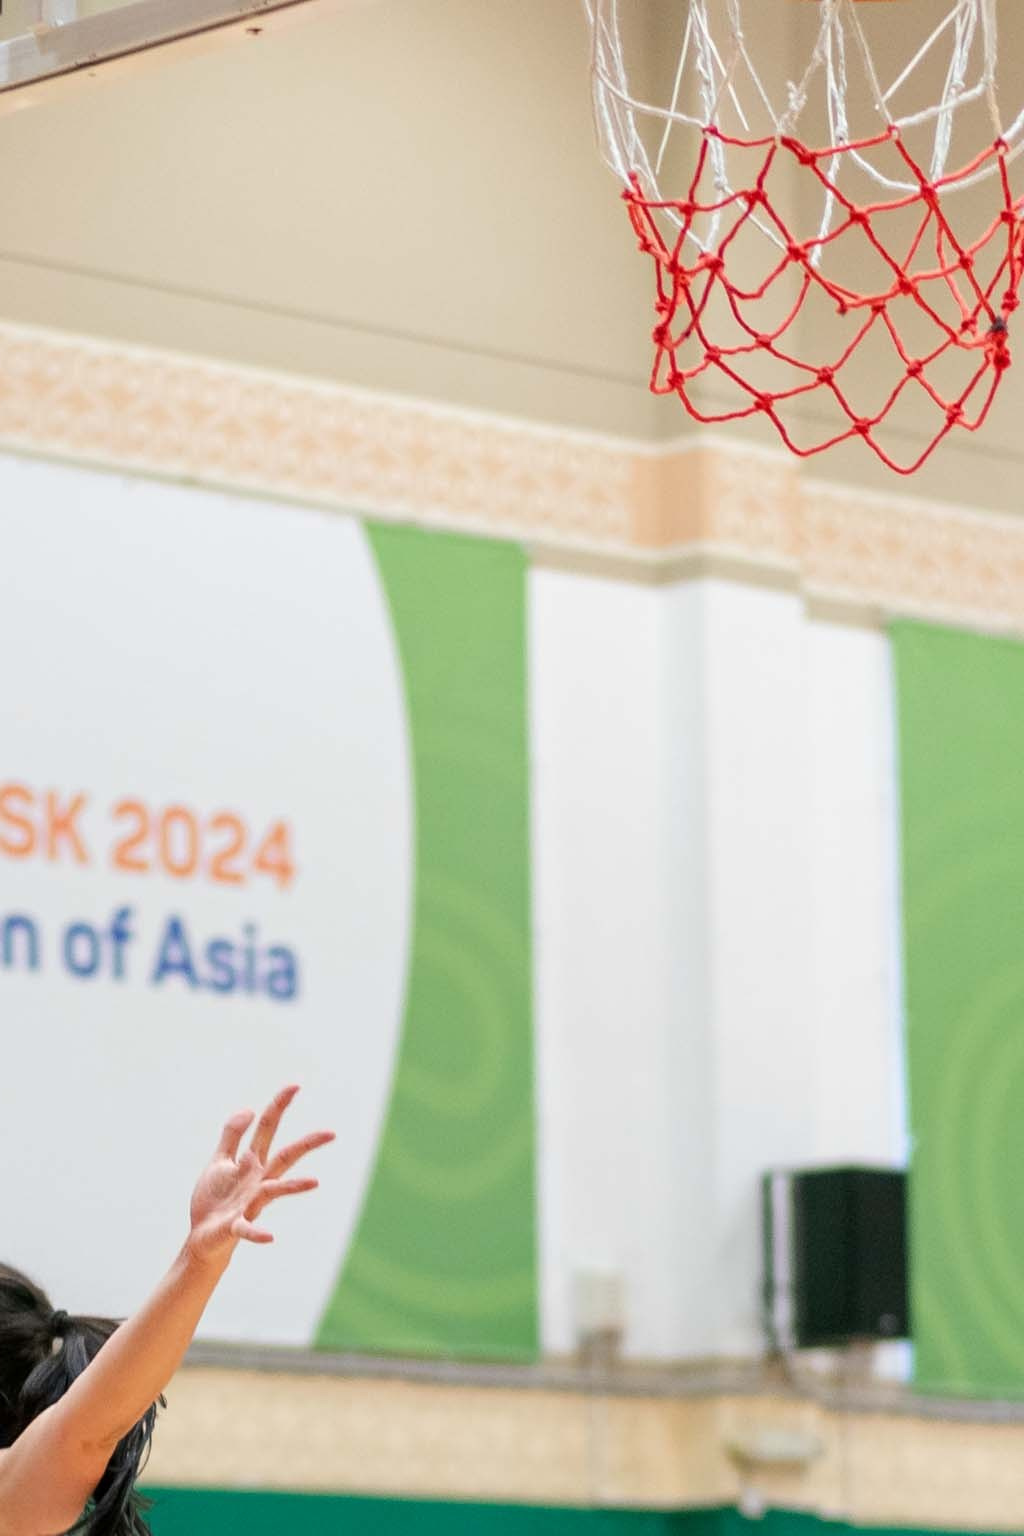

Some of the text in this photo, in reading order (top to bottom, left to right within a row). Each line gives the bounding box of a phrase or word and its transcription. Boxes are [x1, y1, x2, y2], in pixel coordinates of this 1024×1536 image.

[111, 799, 295, 888] 2024
[63, 906, 135, 981] of
[150, 912, 298, 1002] Asia
